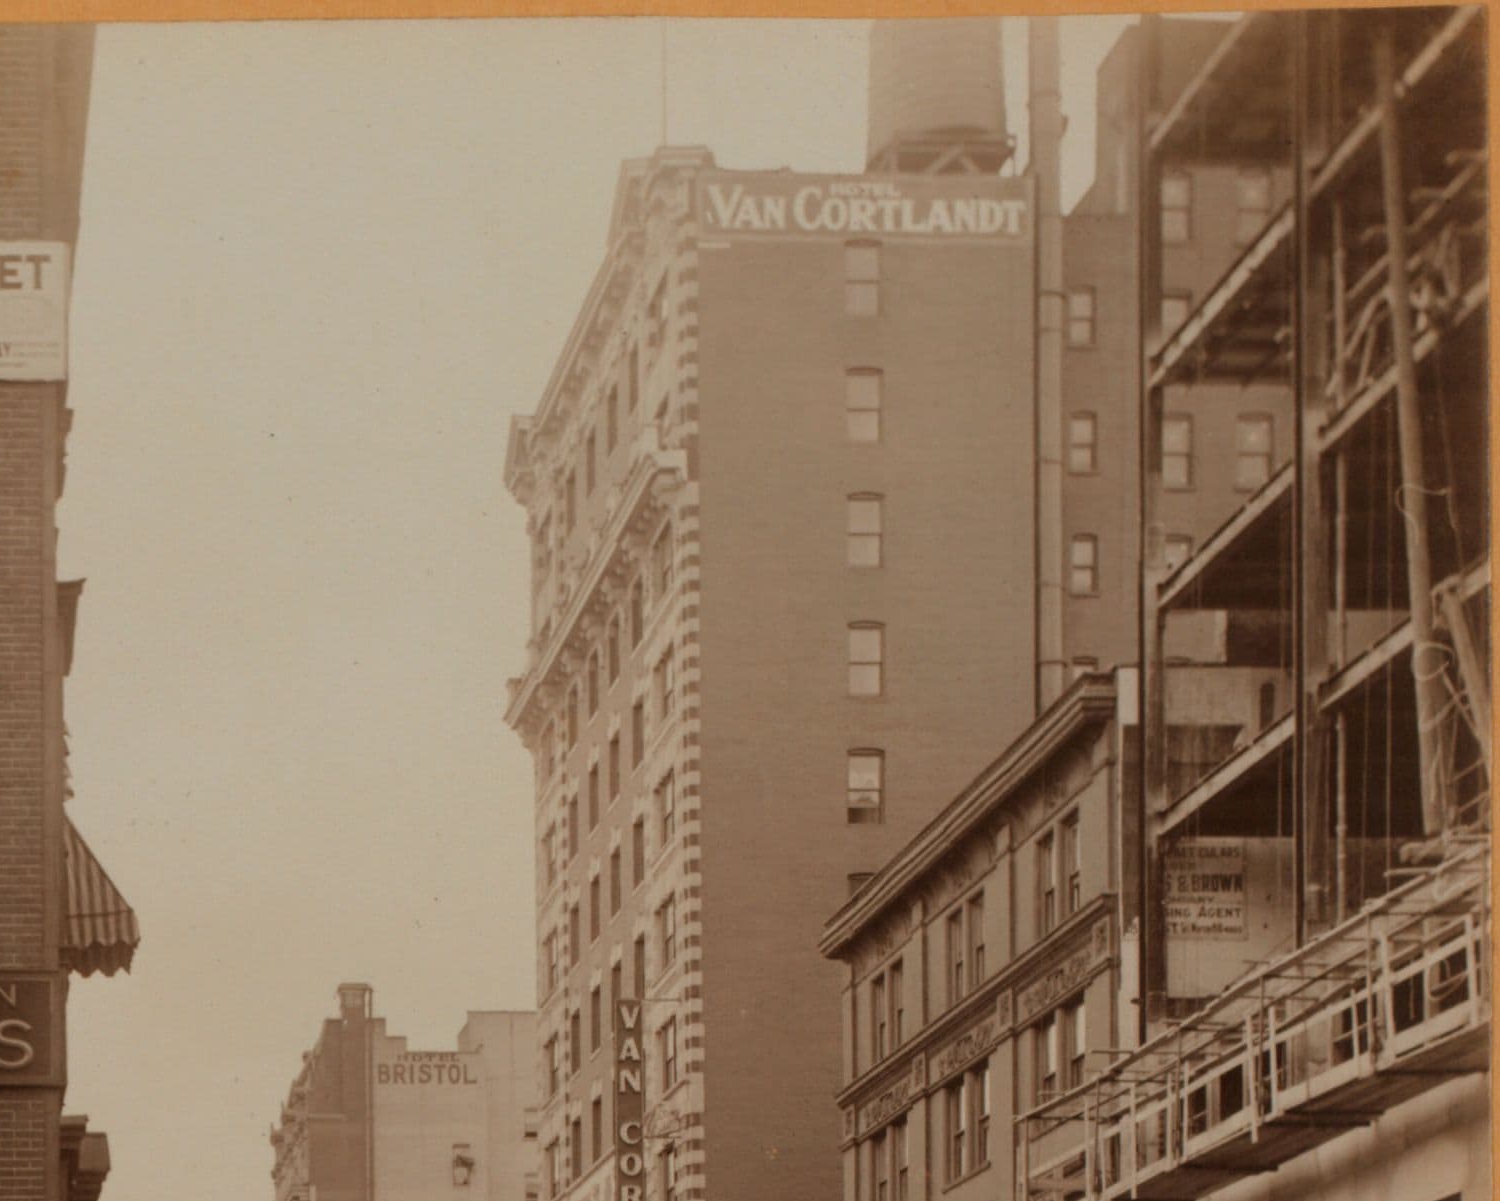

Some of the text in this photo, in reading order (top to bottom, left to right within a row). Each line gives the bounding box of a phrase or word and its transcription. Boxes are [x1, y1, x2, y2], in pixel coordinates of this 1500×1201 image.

[706, 183, 1028, 233] VAN CORTLANDT
[1191, 874, 1243, 893] BROWN
[1197, 905, 1241, 918] AGENT
[618, 1005, 643, 1093] VAN
[376, 1064, 478, 1084] BRISTOL
